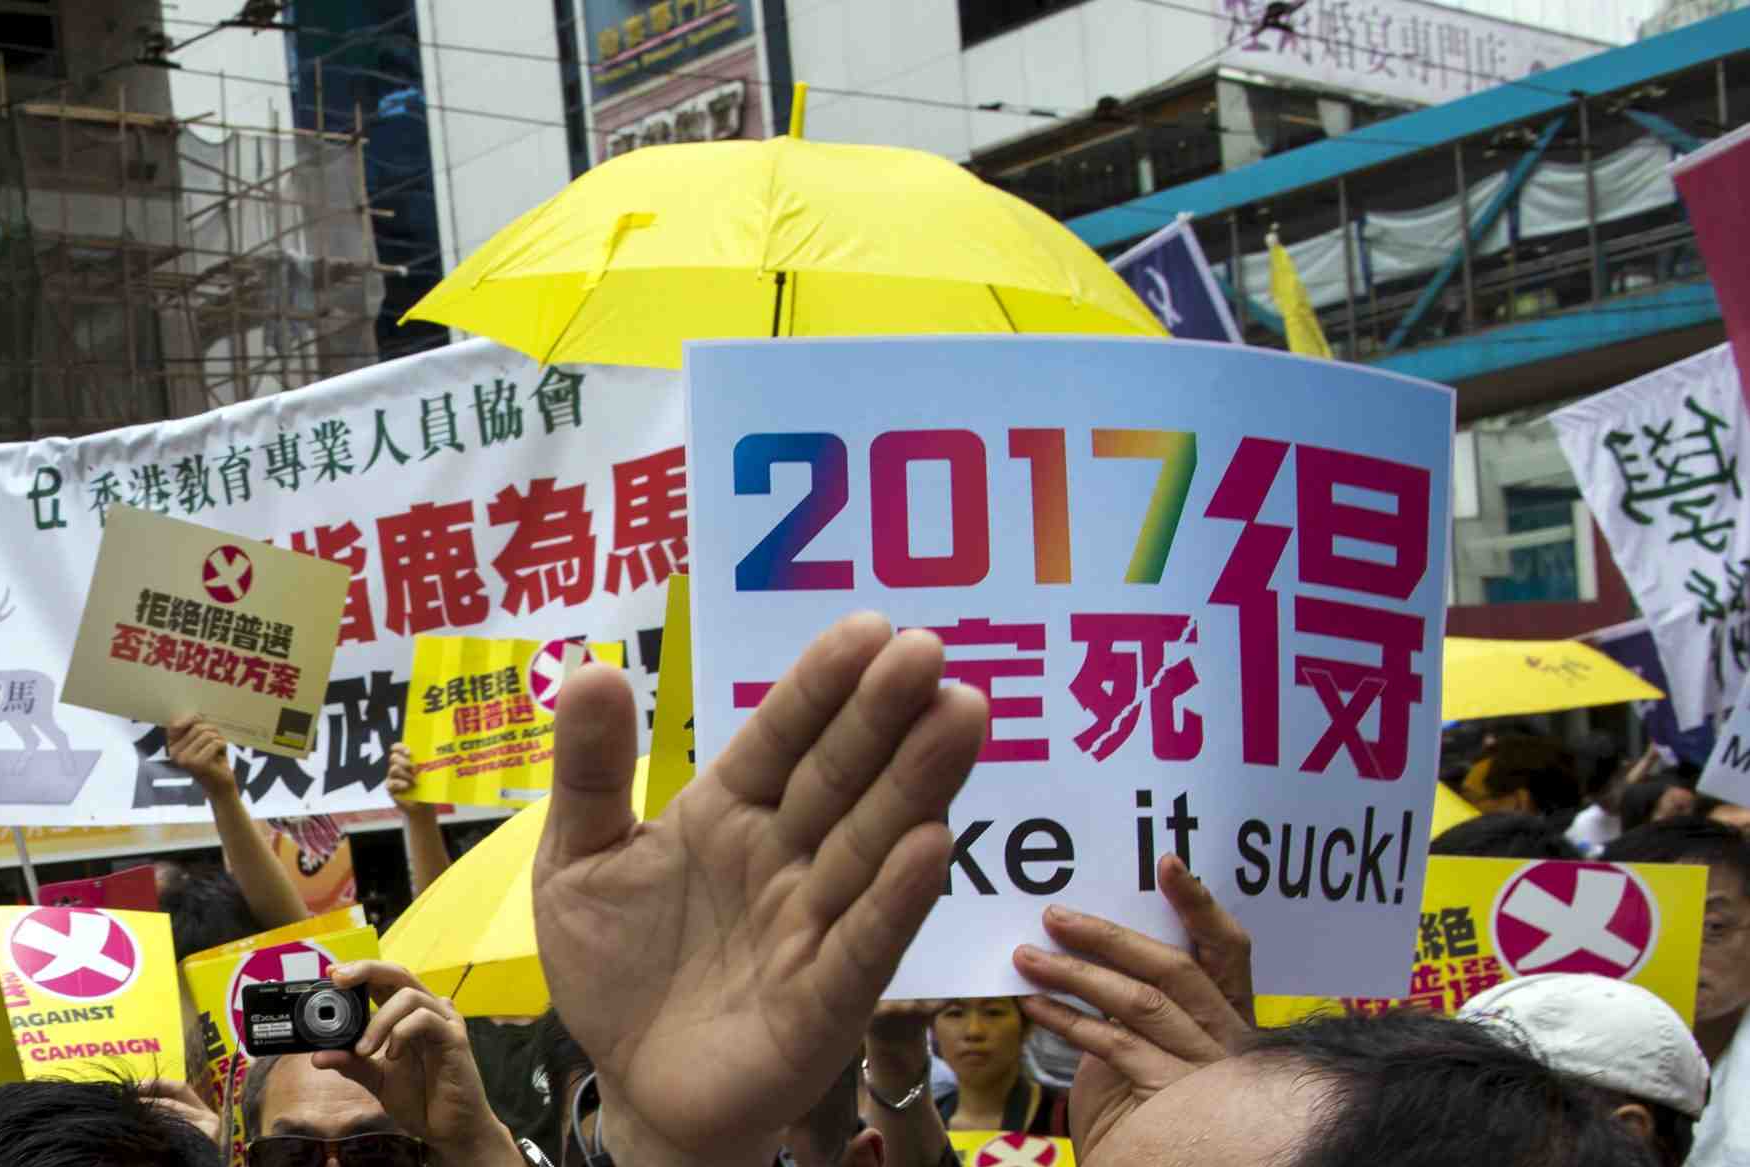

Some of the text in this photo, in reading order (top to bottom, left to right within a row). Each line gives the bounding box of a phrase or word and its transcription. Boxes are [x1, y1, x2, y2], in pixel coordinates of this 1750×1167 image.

[733, 427, 1198, 591] 2017
[109, 623, 301, 700] 否決政改方案
[948, 790, 1413, 907] ke it suck!
[11, 1005, 115, 1029] AGAINST
[30, 1037, 161, 1062] CAMPAIGN
